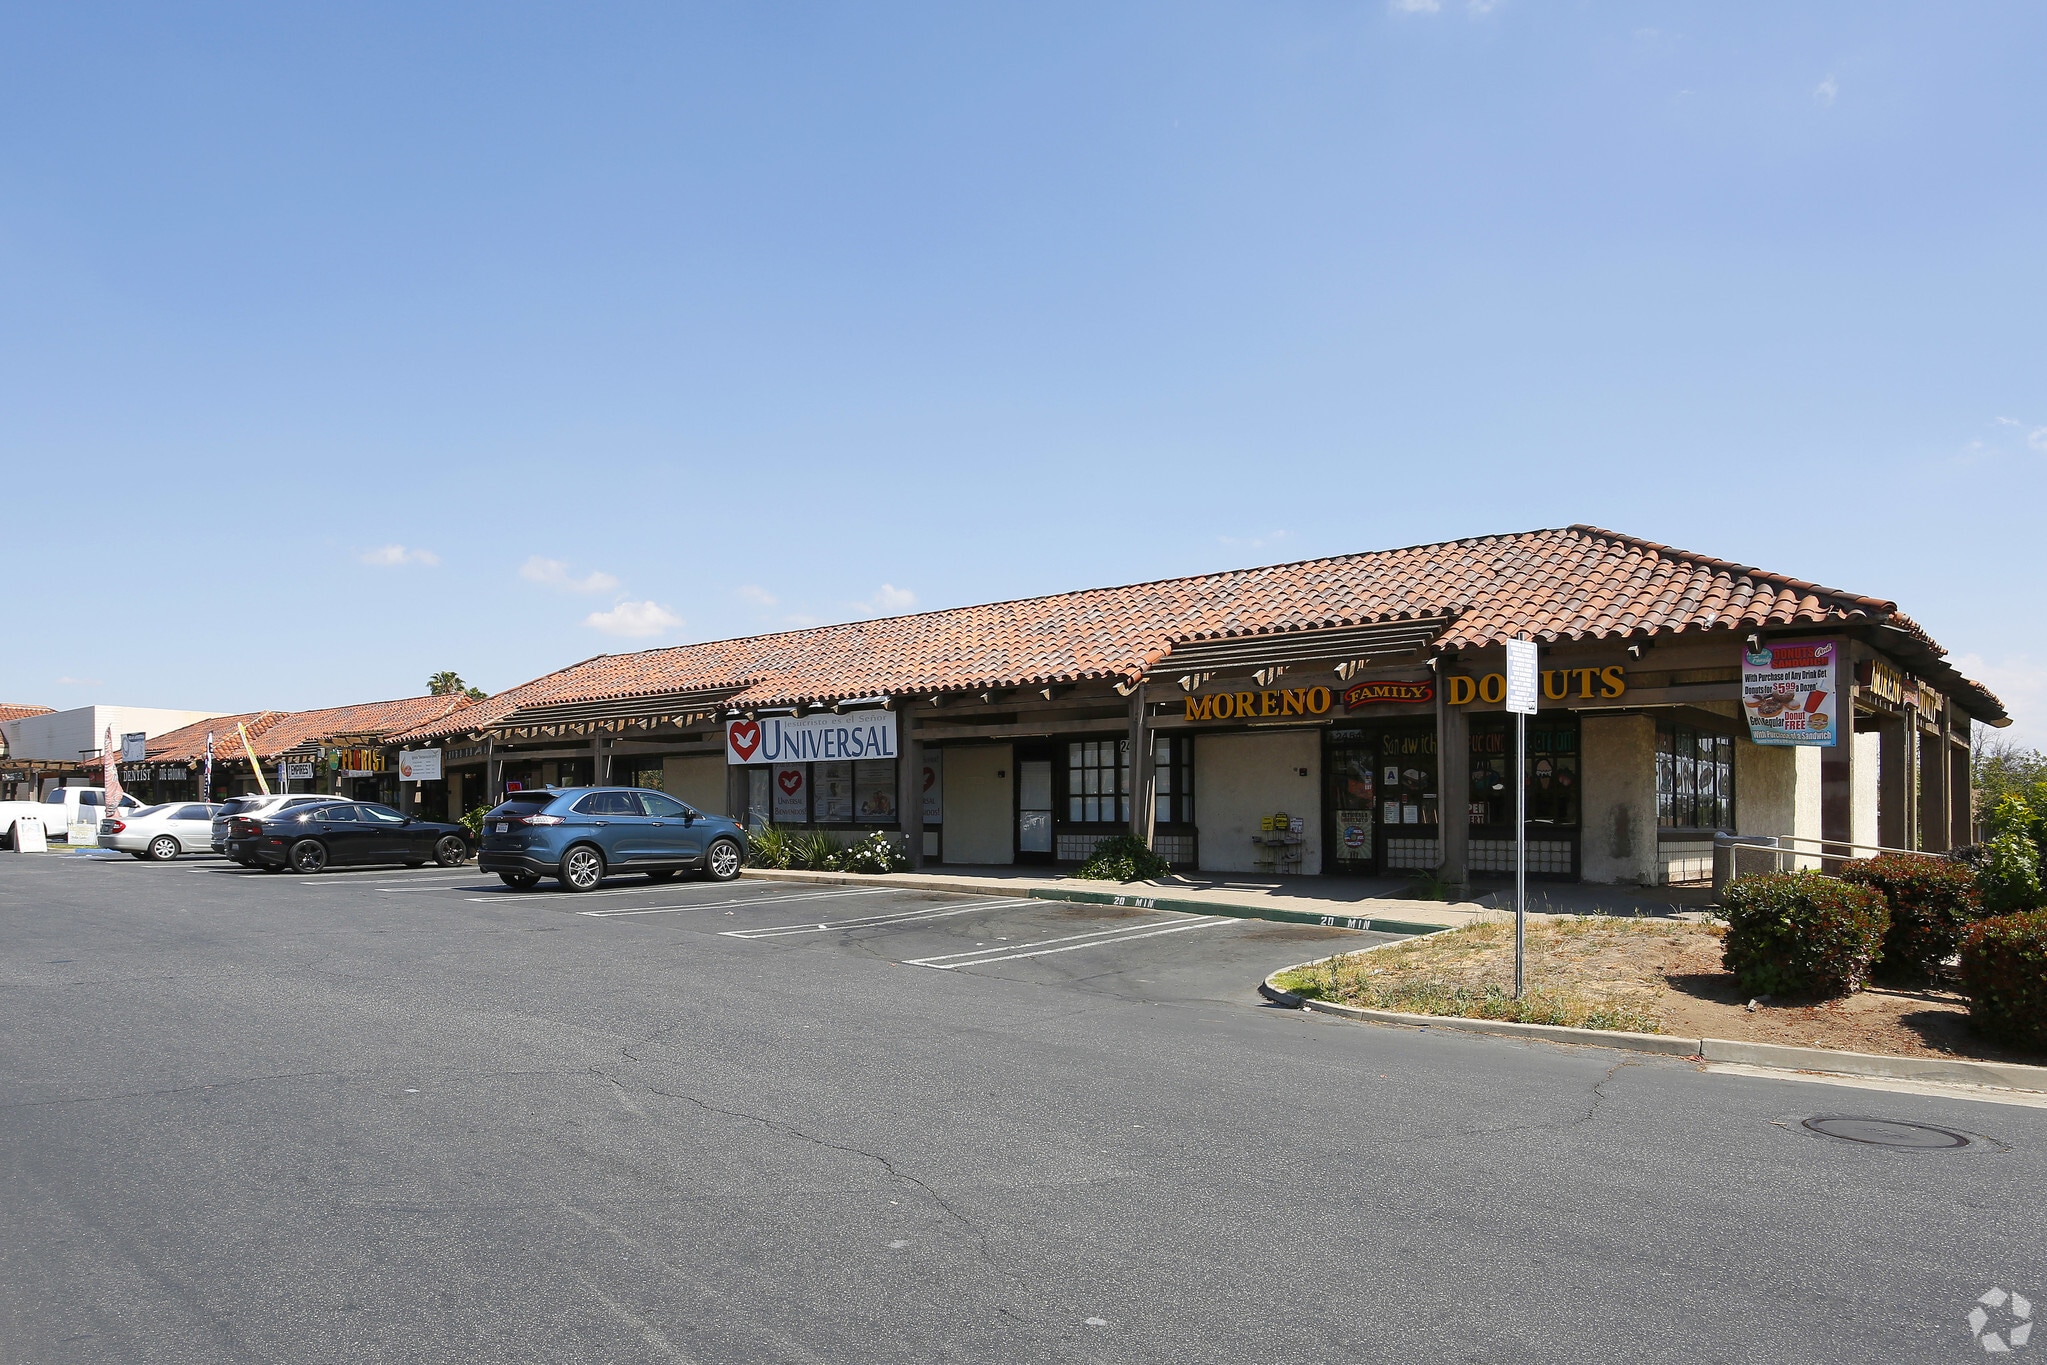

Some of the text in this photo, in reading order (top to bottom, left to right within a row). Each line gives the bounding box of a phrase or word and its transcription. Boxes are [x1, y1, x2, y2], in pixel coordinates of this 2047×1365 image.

[1773, 647, 1815, 659] DONUTS
[1772, 657, 1829, 669] SANDWICH
[1744, 669, 1827, 682] With Purchase of Any Drink Get
[1447, 665, 1625, 705] DOUTS
[1744, 686, 1764, 695] Donuts
[1764, 685, 1773, 694] for
[1350, 686, 1427, 705] FAMILY
[1184, 686, 1331, 721] MORENO
[784, 716, 828, 729] Jesucristo
[846, 715, 855, 723] el
[858, 713, 888, 723] Señor
[1784, 711, 1806, 721] Donut
[1784, 720, 1806, 730] FREE
[760, 720, 894, 760] UNIVERSAL
[1801, 730, 1832, 740] Sandwich
[123, 768, 152, 782] DENTIST
[1387, 770, 1396, 780] A
[1469, 803, 1485, 814] PEN
[1113, 896, 1155, 908] 20 MIN
[1320, 916, 1372, 931] 20 MIN
